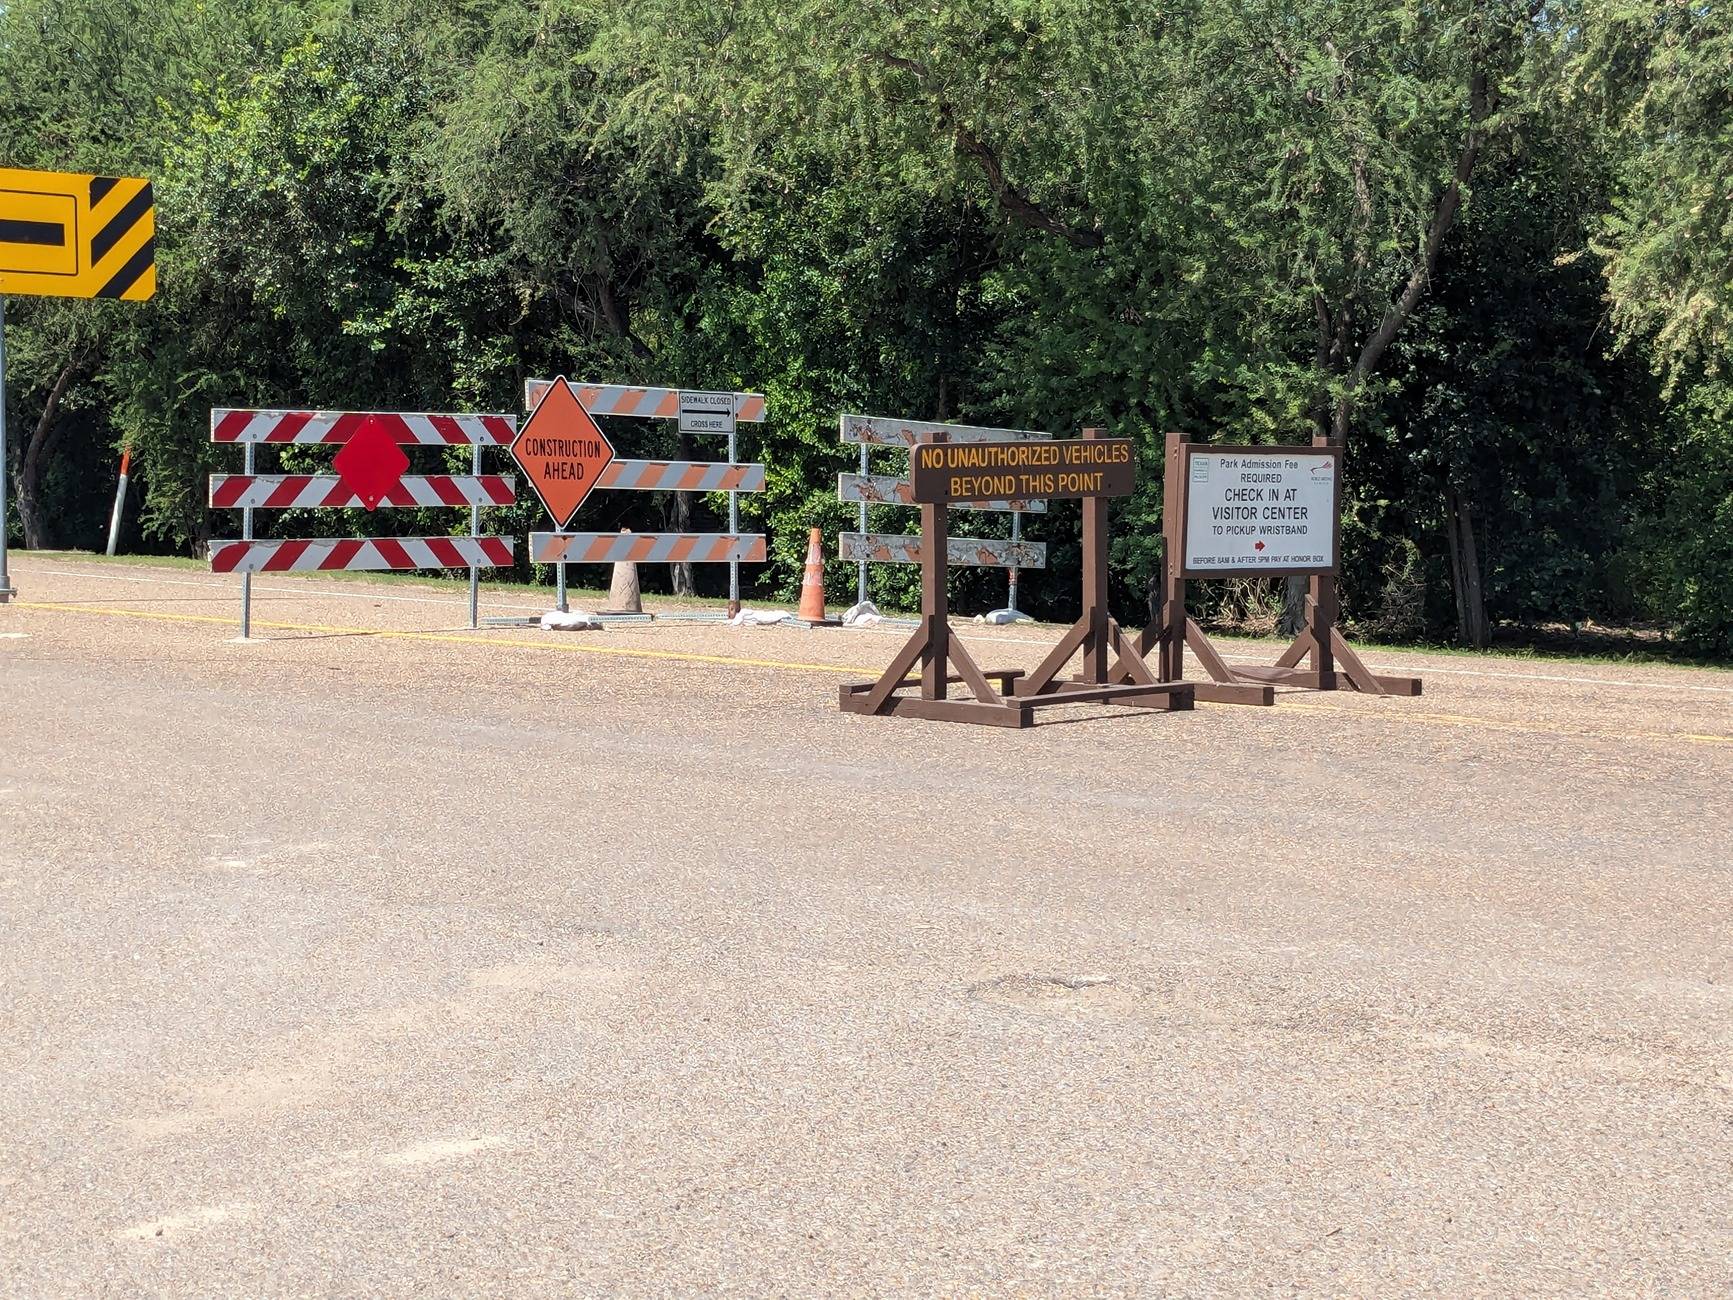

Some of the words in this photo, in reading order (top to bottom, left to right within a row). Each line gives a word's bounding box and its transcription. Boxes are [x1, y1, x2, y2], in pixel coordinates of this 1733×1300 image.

[681, 395, 709, 404] SIDEWALK
[710, 396, 731, 405] CLOSED
[690, 420, 708, 428] CROSS
[709, 420, 723, 428] HERE
[525, 438, 601, 459] CONSTRUCTION
[921, 448, 944, 469] NO
[947, 446, 1060, 469] UNAUTHORIZED
[1063, 444, 1129, 465] VEHICLES
[1220, 458, 1238, 469] Park
[1241, 458, 1282, 469] Admission
[1284, 459, 1299, 469] Fee
[543, 462, 584, 481] AHEAD
[951, 475, 1016, 497] BEYOND
[1019, 474, 1055, 494] THIS
[1058, 472, 1104, 493] POINT
[1240, 473, 1282, 484] REQUIRED
[1224, 488, 1264, 502] CHECK
[1268, 488, 1279, 502] IN
[1284, 488, 1298, 501] AT
[1212, 506, 1257, 520] VISITOR
[1262, 507, 1308, 520] CENTER
[1212, 525, 1223, 535] TO
[1226, 525, 1256, 535] PICKUP
[1259, 525, 1308, 535] WRISTBAND
[1193, 556, 1216, 564] BEFORE
[1237, 555, 1257, 564] AFTER
[1290, 555, 1311, 563] HONOR
